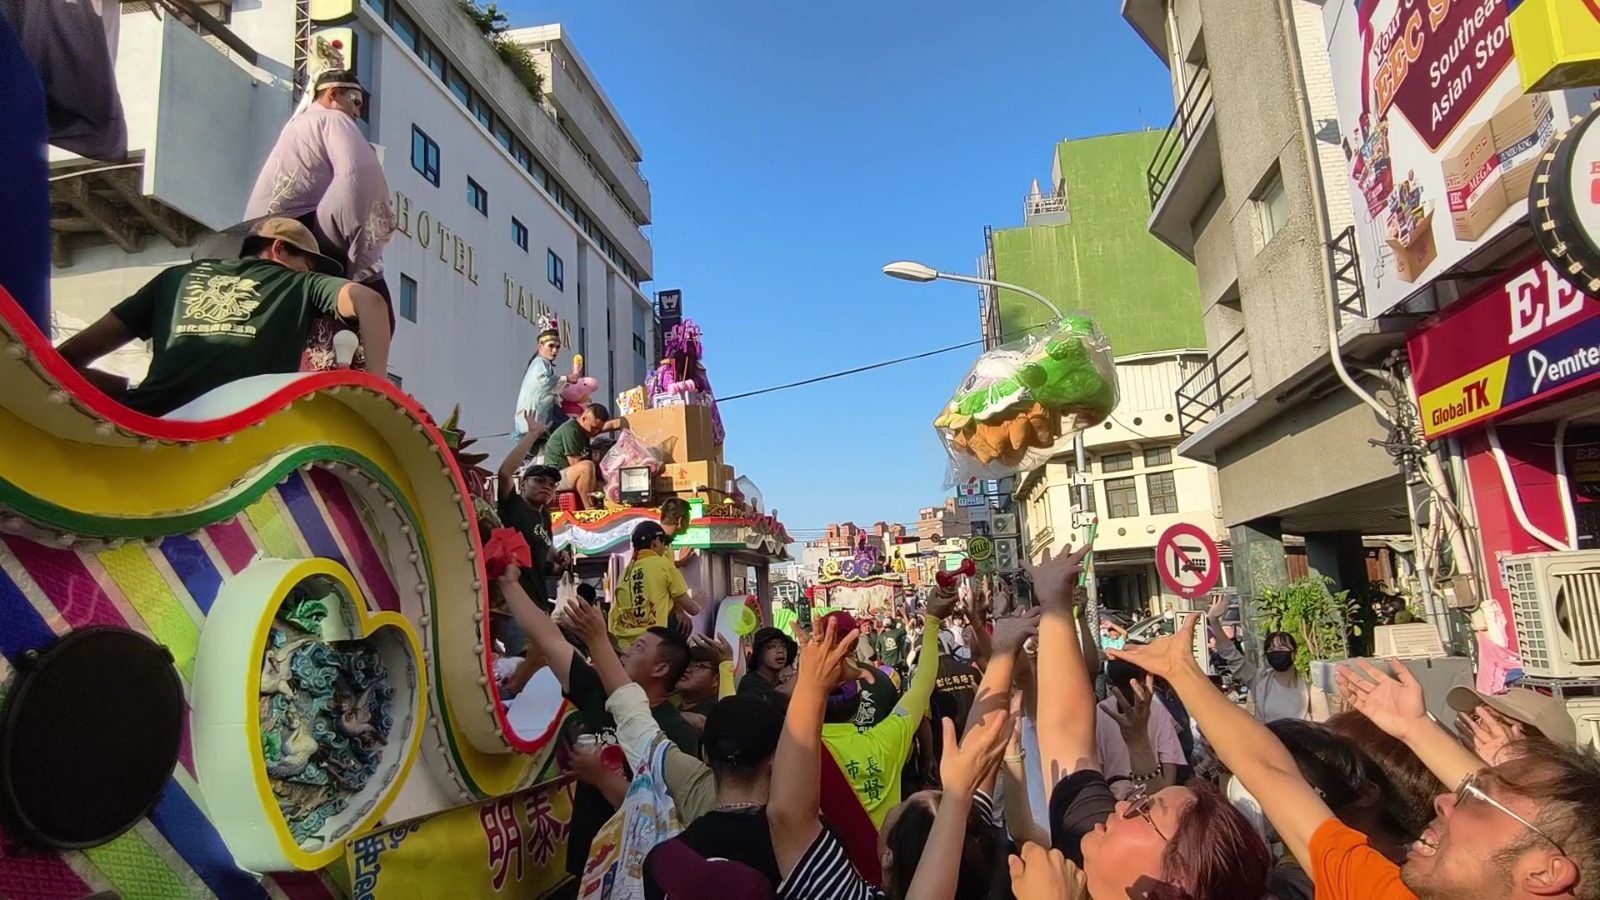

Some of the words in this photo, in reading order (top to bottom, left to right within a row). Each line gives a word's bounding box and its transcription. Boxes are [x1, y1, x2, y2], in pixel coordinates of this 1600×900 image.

[1374, 9, 1424, 118] EEC
[1430, 0, 1502, 88] Southea
[1432, 64, 1472, 131] Asian
[1469, 162, 1492, 192] MEGA
[395, 191, 479, 286] HOTEL
[1432, 376, 1490, 427] GlobalTK
[1528, 345, 1600, 394] Demite
